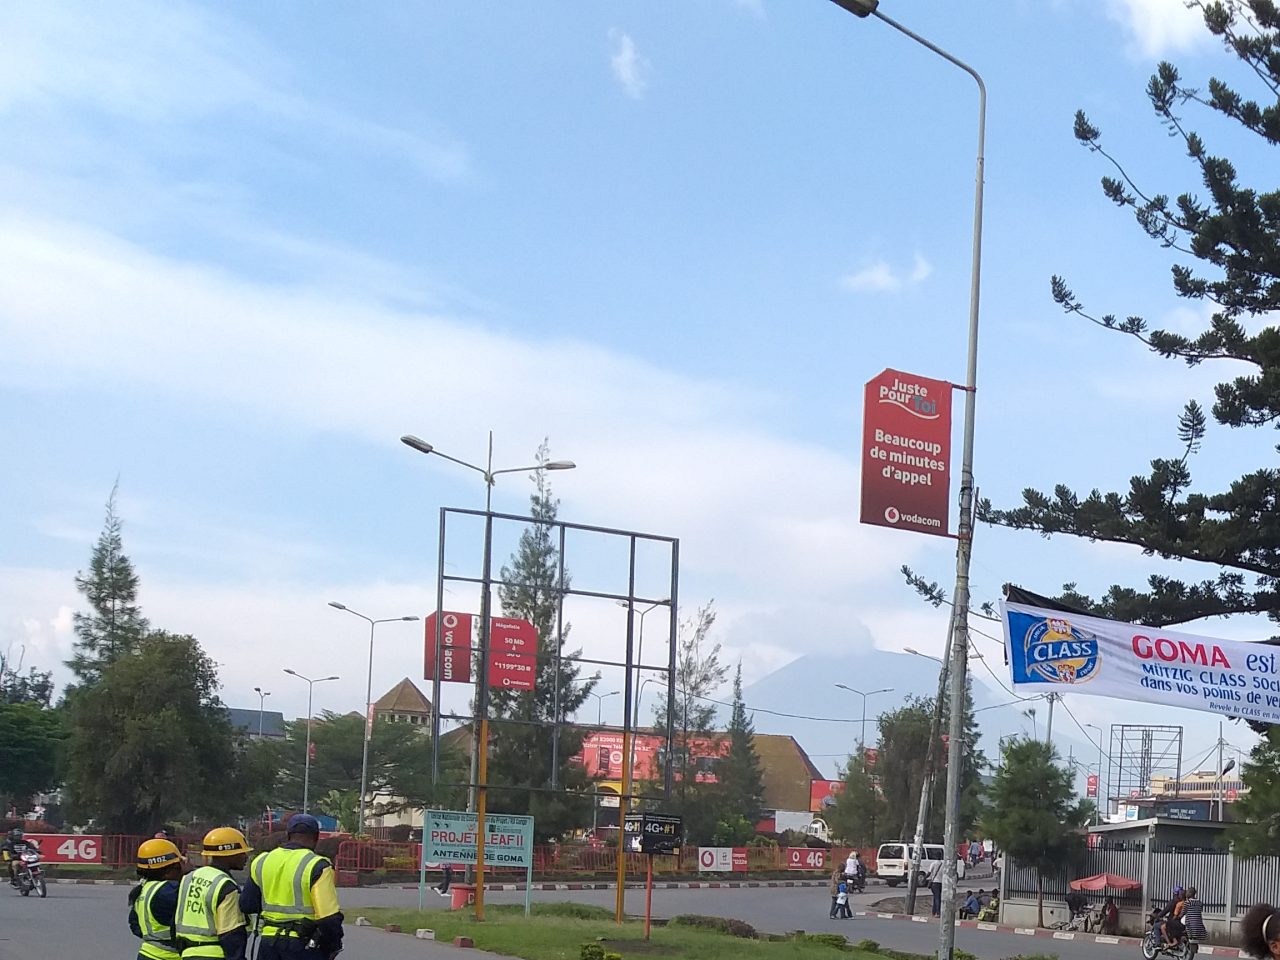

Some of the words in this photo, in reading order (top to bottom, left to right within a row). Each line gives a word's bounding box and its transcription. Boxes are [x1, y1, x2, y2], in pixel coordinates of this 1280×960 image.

[892, 378, 928, 397] Juste
[879, 385, 912, 404] Pour
[912, 396, 936, 415] Toi
[875, 428, 941, 456] Beaucoup
[870, 446, 888, 460] de
[889, 450, 945, 471] minutes
[900, 512, 941, 527] vodacom
[1033, 642, 1093, 661] CLASS
[1132, 635, 1231, 669] GOMA
[1246, 653, 1278, 674] est
[1142, 662, 1193, 682] MÜTZIG
[1199, 671, 1247, 687] CLASS
[1253, 676, 1280, 692] 50cl
[1140, 676, 1172, 691] dans
[1176, 682, 1198, 695] vos
[1203, 686, 1241, 701] points
[1246, 691, 1261, 704] de
[1241, 706, 1261, 717] CLASS
[431, 830, 478, 844] PROJET
[57, 839, 97, 860] 4G
[497, 854, 524, 863] GOMA
[806, 851, 823, 867] 4G
